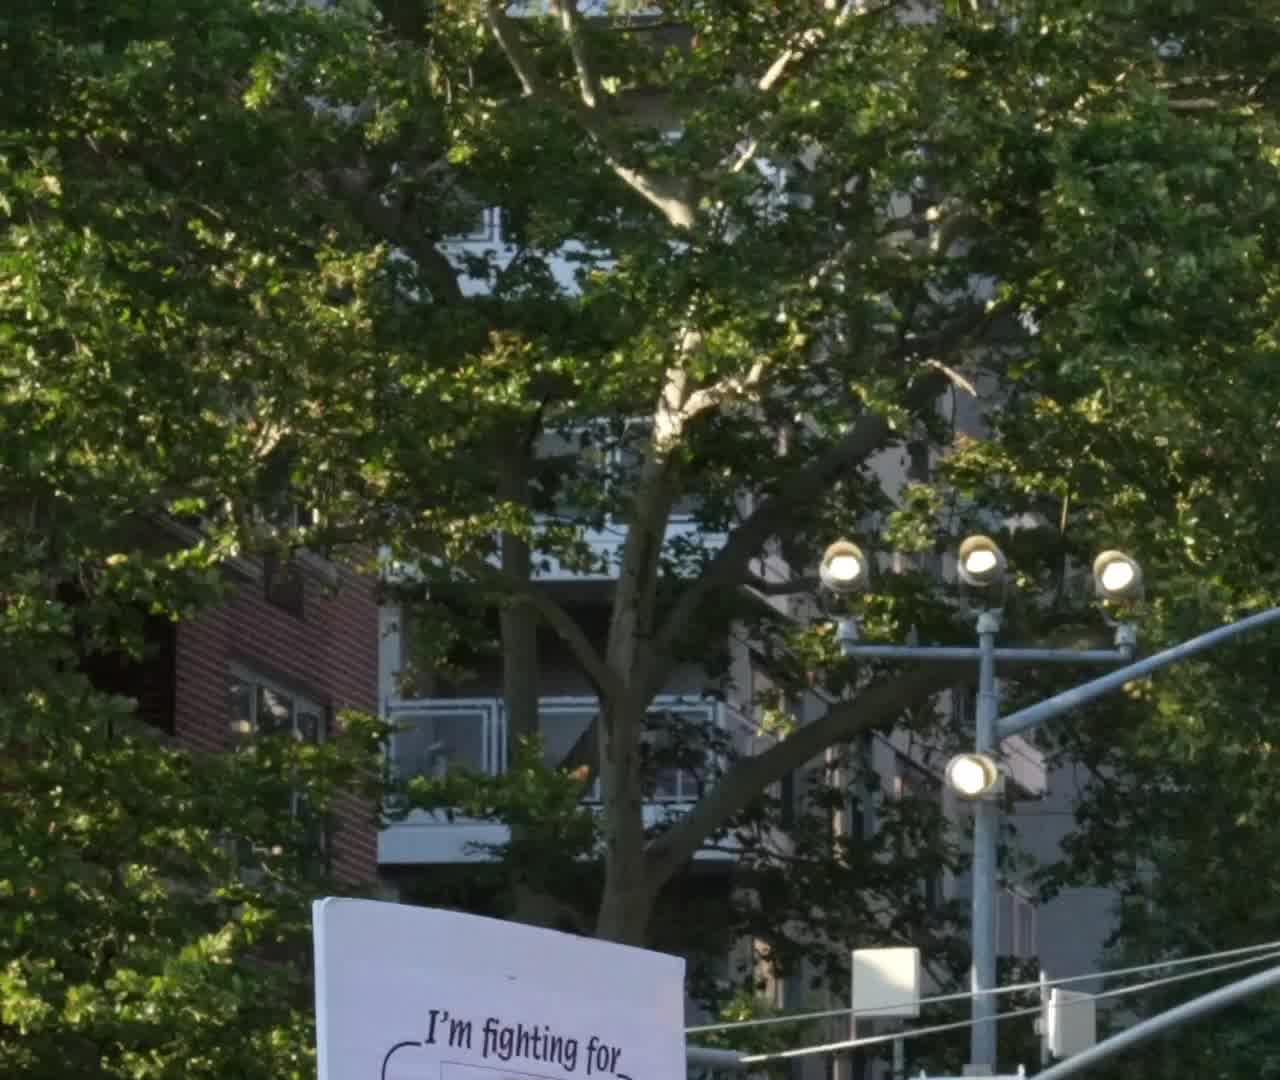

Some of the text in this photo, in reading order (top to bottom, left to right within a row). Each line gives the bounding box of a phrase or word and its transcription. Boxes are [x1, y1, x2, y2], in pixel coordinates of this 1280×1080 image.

[424, 1009, 622, 1076] I'm fighting for
